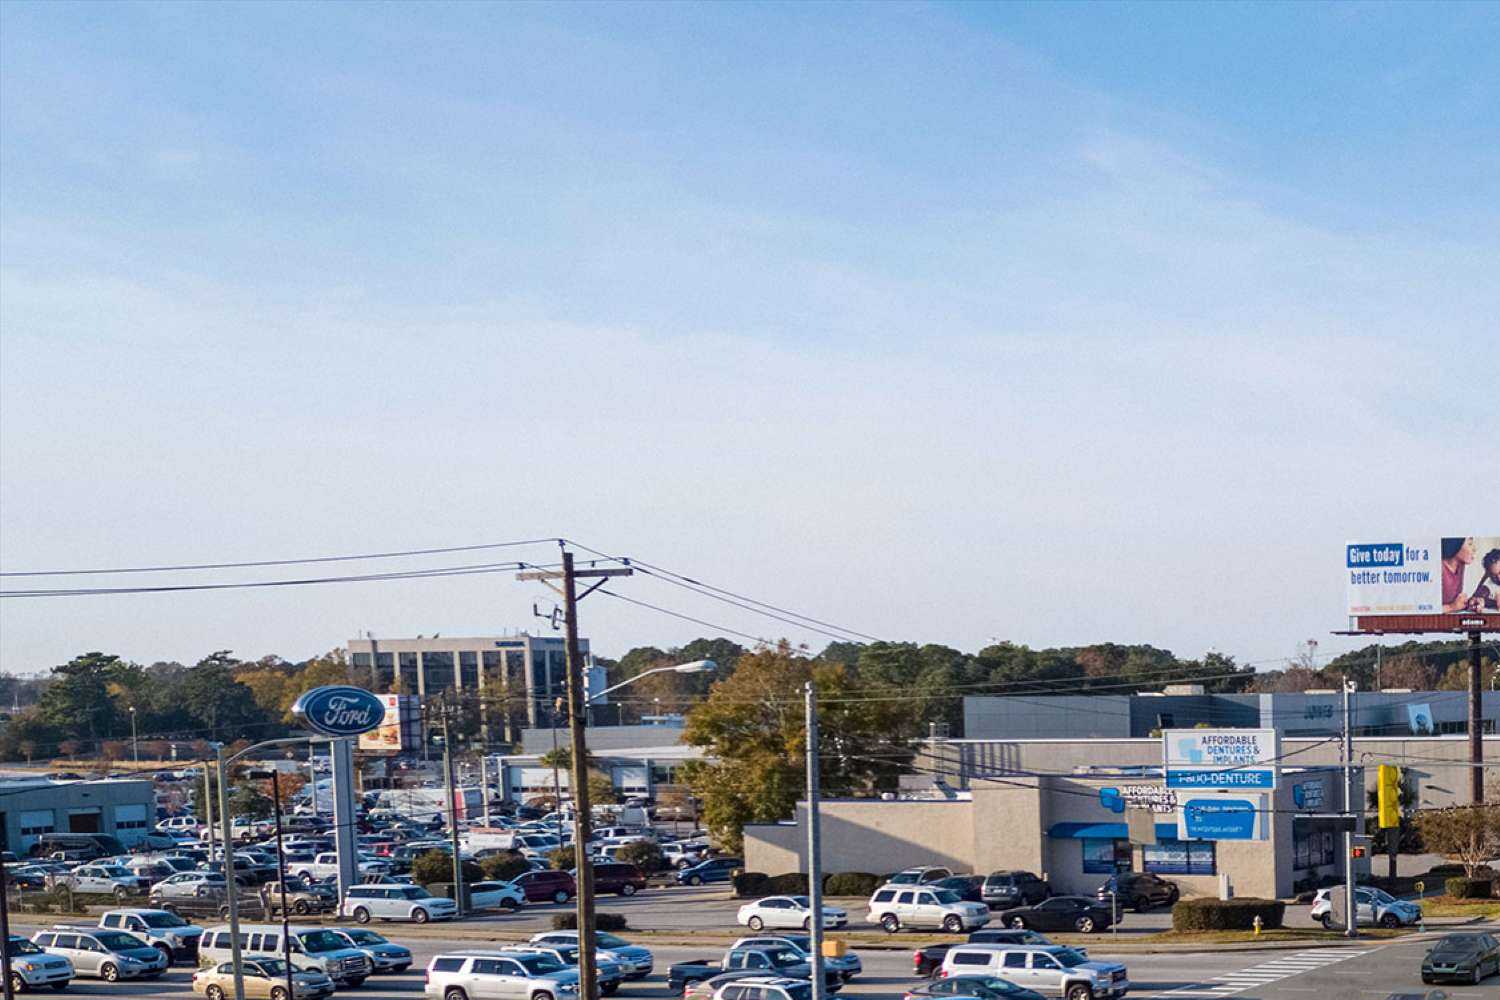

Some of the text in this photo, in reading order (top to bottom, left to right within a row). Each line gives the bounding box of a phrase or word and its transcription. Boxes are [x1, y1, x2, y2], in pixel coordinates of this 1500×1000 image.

[1350, 547, 1429, 565] Give today for a
[1351, 571, 1433, 584] better tomorrow.
[323, 696, 371, 726] Ford
[1201, 735, 1257, 745] AFFORDABLE
[1207, 746, 1252, 755] DENTURES
[1213, 756, 1256, 765] IMPLANTS
